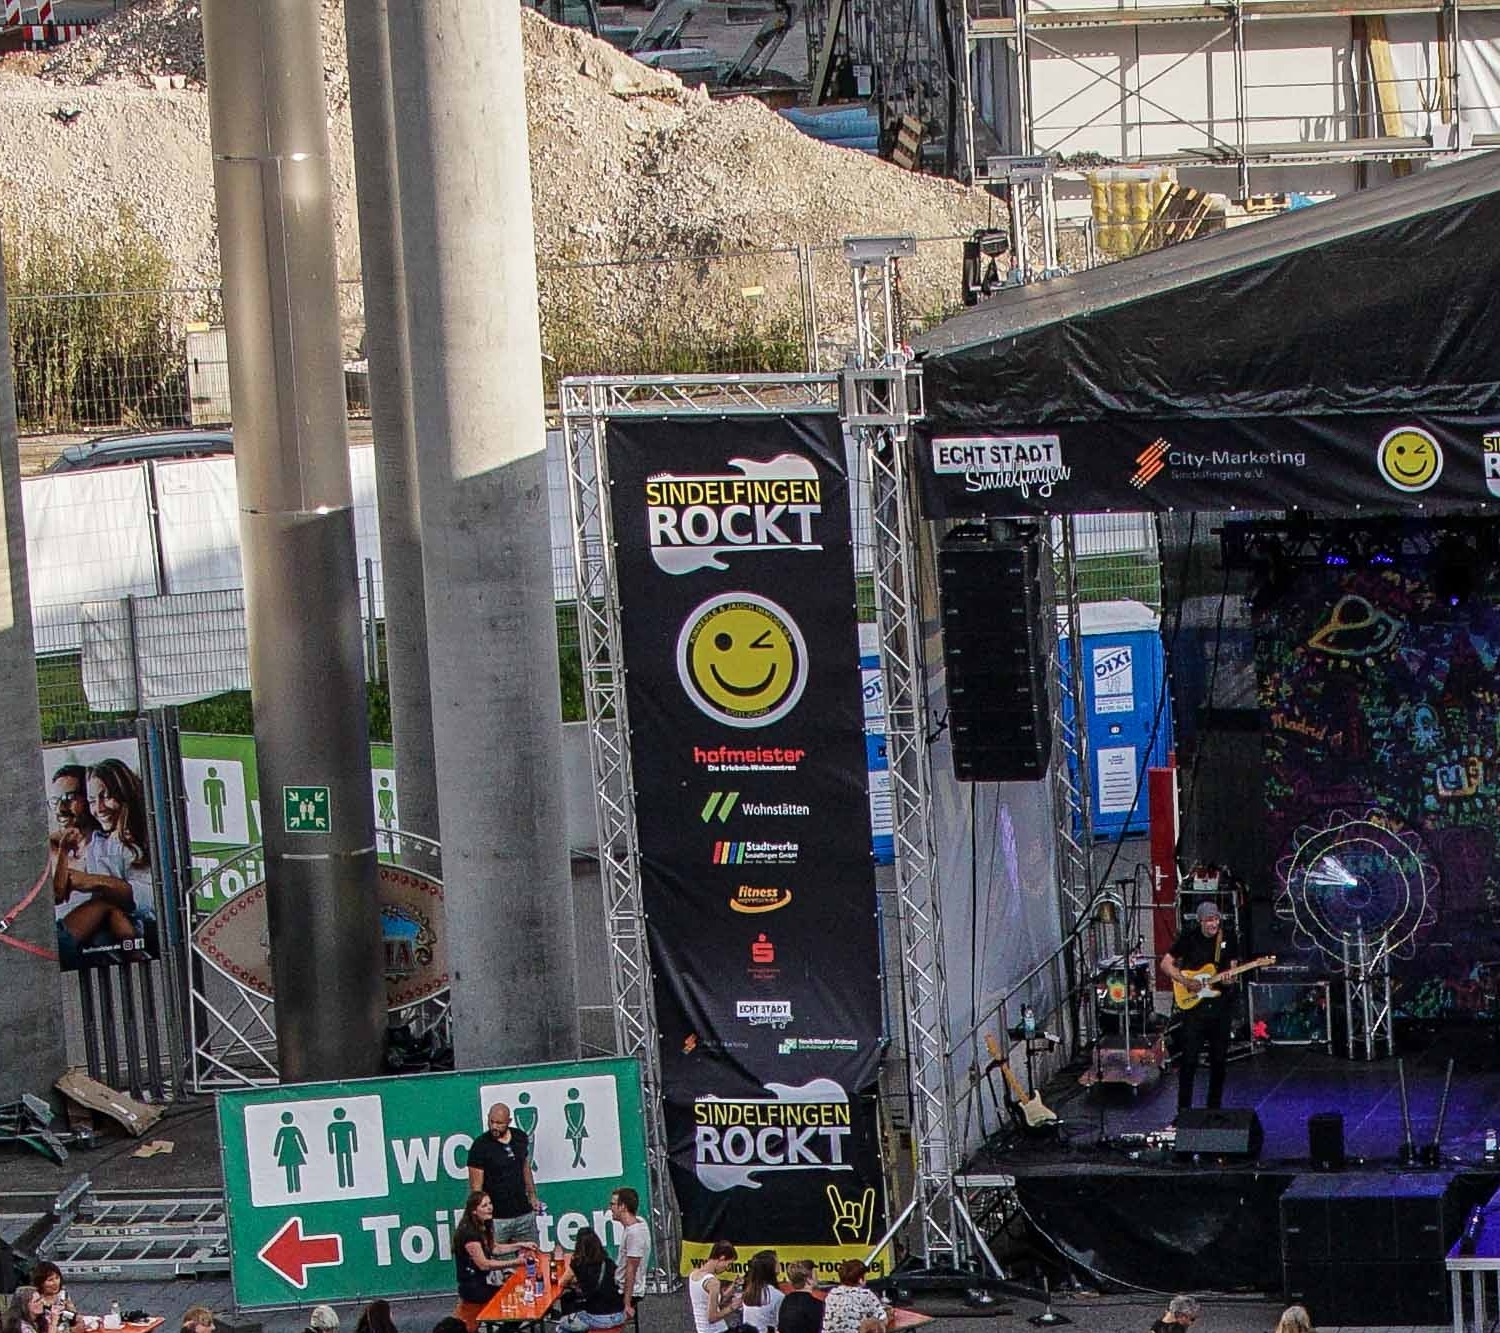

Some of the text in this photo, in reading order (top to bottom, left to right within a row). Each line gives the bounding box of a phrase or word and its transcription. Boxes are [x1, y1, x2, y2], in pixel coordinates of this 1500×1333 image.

[939, 443, 1055, 465] ECHT STADT
[1169, 450, 1306, 468] City-Marketing
[964, 462, 1071, 499] Sindelfingen
[647, 480, 820, 505] SINDELFINGEN
[649, 503, 821, 546] ROCKT
[1095, 650, 1132, 678] DIXI
[694, 746, 805, 763] hofmeister
[742, 802, 810, 816] Wohnstätten
[746, 841, 799, 852] Stadtwerke
[738, 885, 779, 898] fitness
[694, 1103, 850, 1126] SINDELFINGEN
[695, 1126, 851, 1164] ROCKT
[391, 1131, 473, 1184] WC
